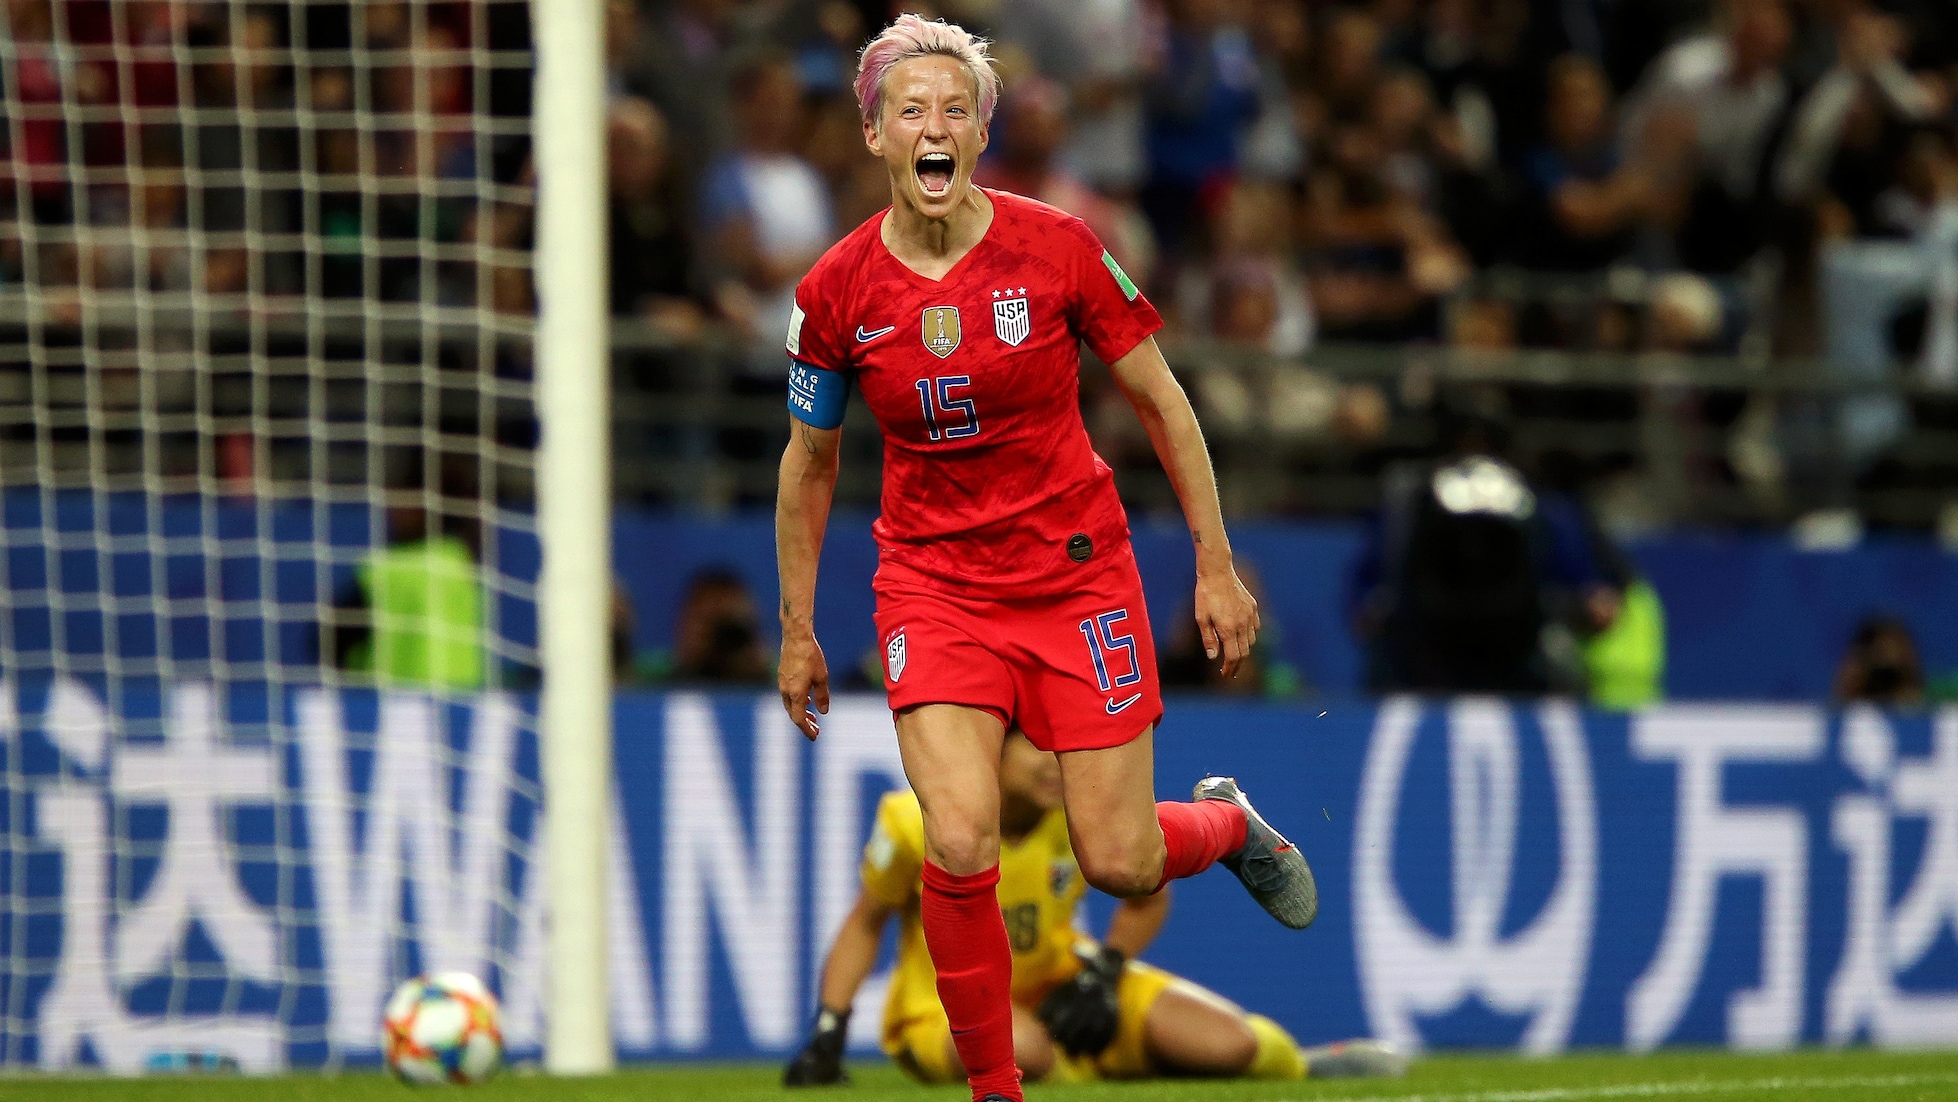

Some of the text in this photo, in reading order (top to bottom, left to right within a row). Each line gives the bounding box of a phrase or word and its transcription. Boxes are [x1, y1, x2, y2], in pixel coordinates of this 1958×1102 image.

[996, 301, 1025, 320] USA
[933, 338, 952, 346] FIFA
[789, 364, 816, 393] BALL
[790, 389, 814, 413] FIFA
[915, 375, 980, 441] 15
[1079, 608, 1141, 692] 15
[0, 675, 288, 1078] 达
[296, 684, 1100, 1056] WAND
